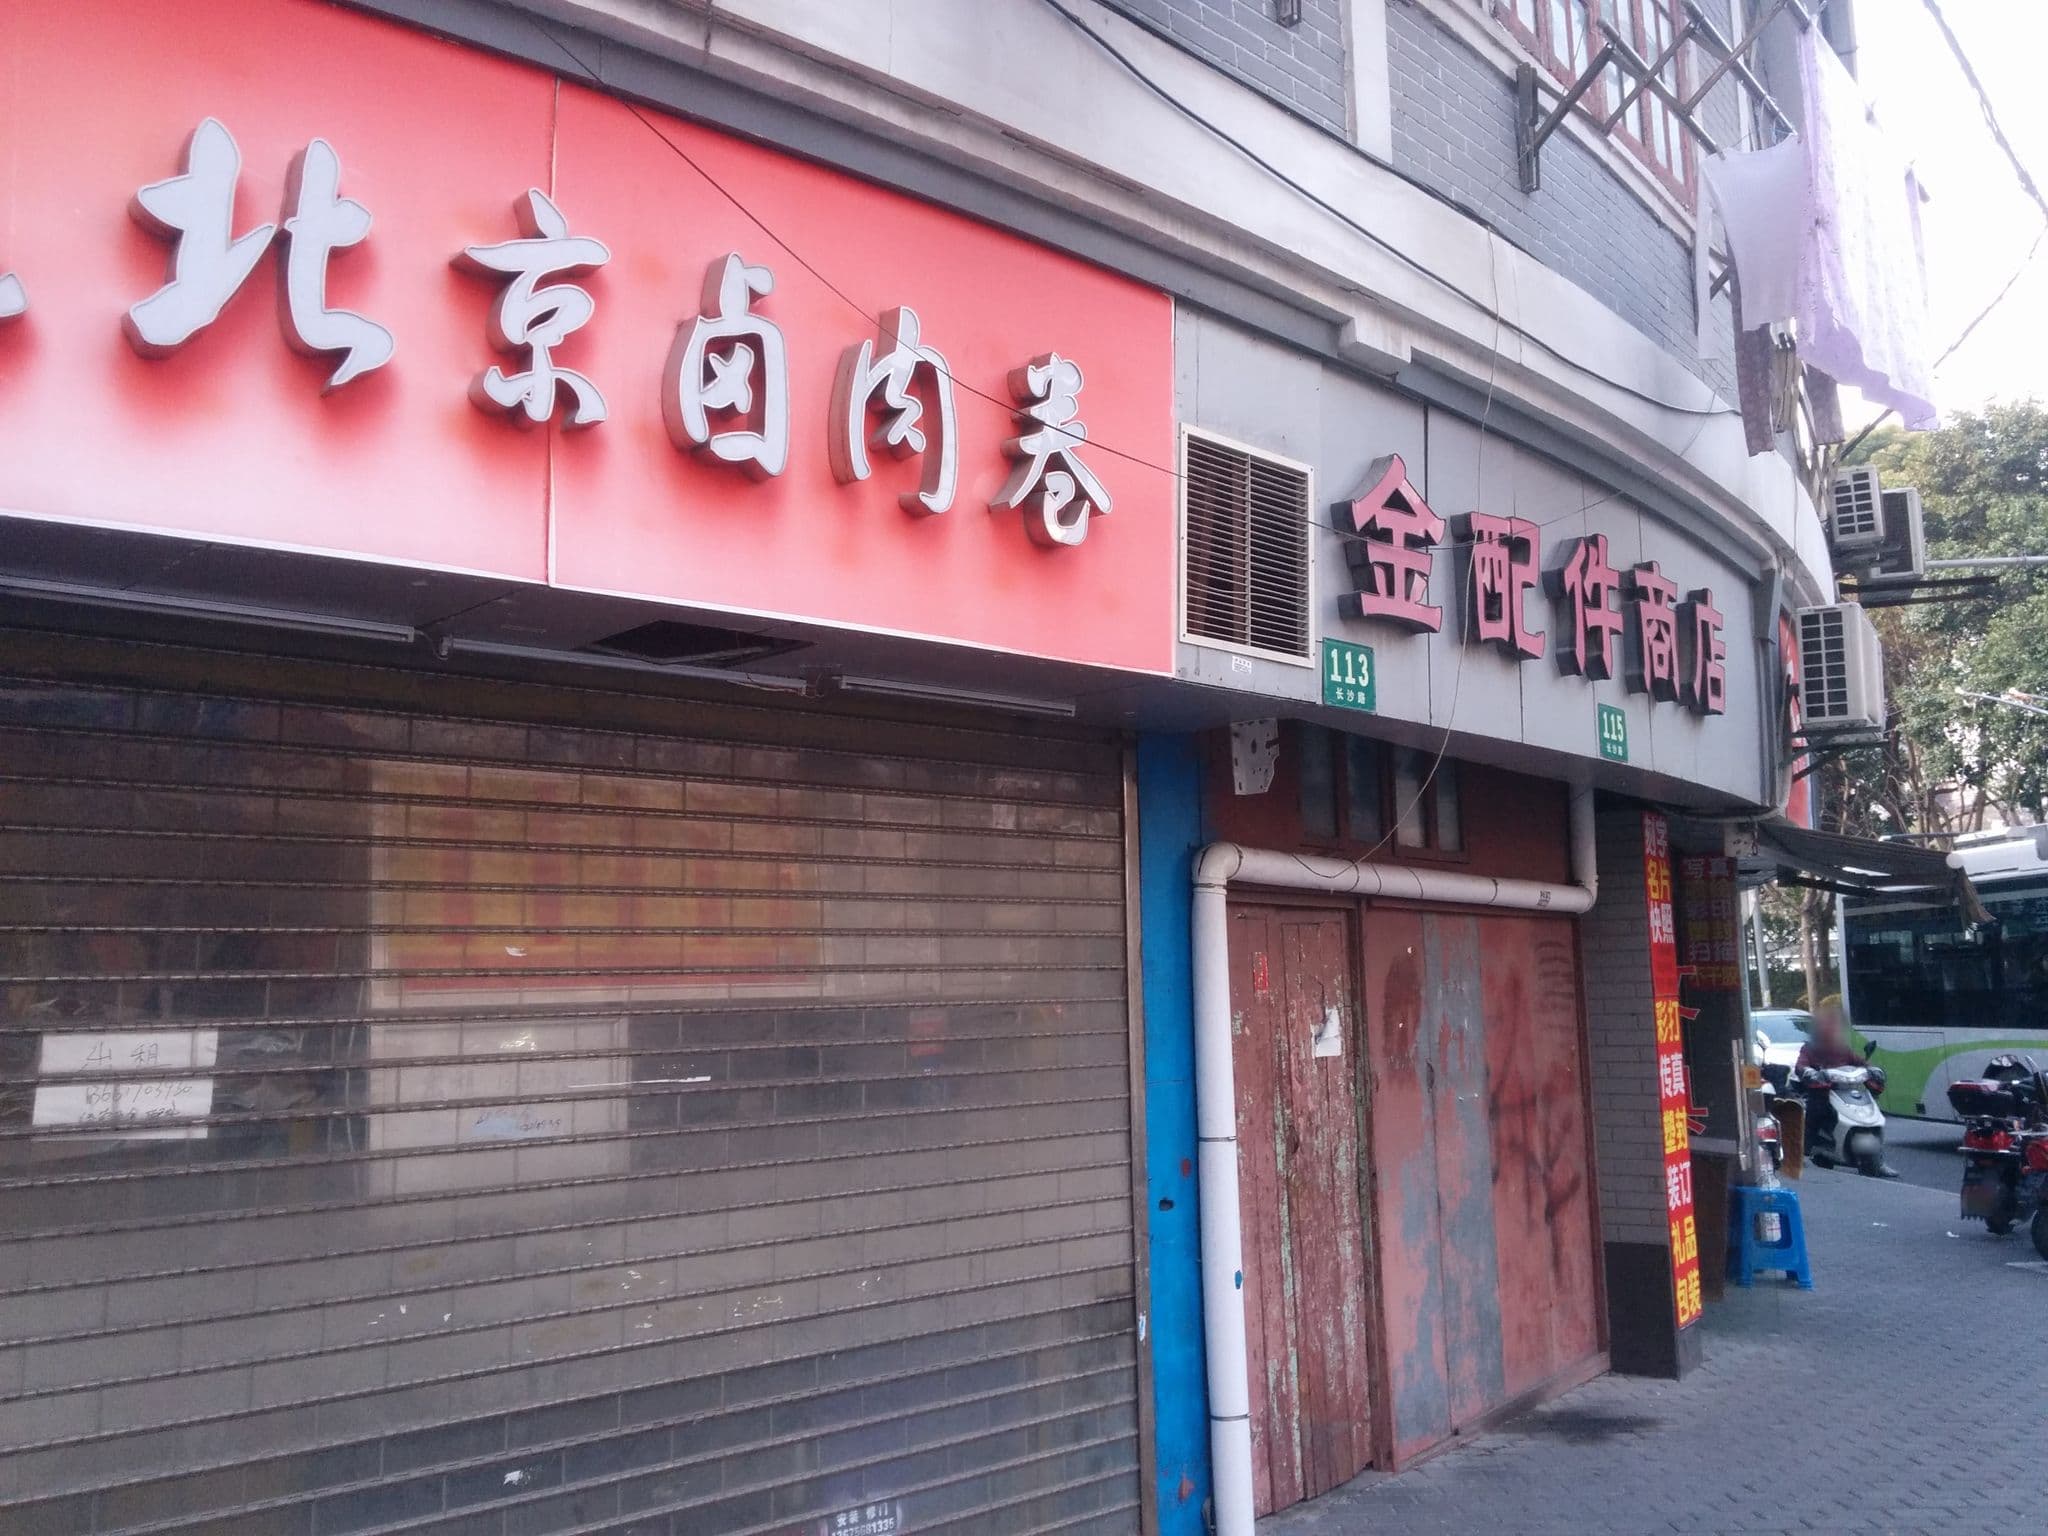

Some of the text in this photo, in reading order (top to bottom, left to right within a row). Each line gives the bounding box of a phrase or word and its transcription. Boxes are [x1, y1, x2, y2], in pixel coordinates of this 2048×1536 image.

[0, 116, 1113, 547] 北京卤肉卷
[1333, 453, 1727, 716] 金配件商店
[1330, 648, 1370, 687] 113
[1335, 687, 1366, 705] 长沙路
[1602, 711, 1624, 742] 115
[1647, 858, 1671, 901] 名片
[1650, 903, 1675, 944] 快照
[1655, 999, 1680, 1043] 彩打
[1659, 1053, 1685, 1099] 传真
[1662, 1110, 1689, 1154] 塑封
[1666, 1160, 1693, 1211] 装订
[1671, 1215, 1698, 1266] 礼品
[1676, 1270, 1702, 1324] 包装
